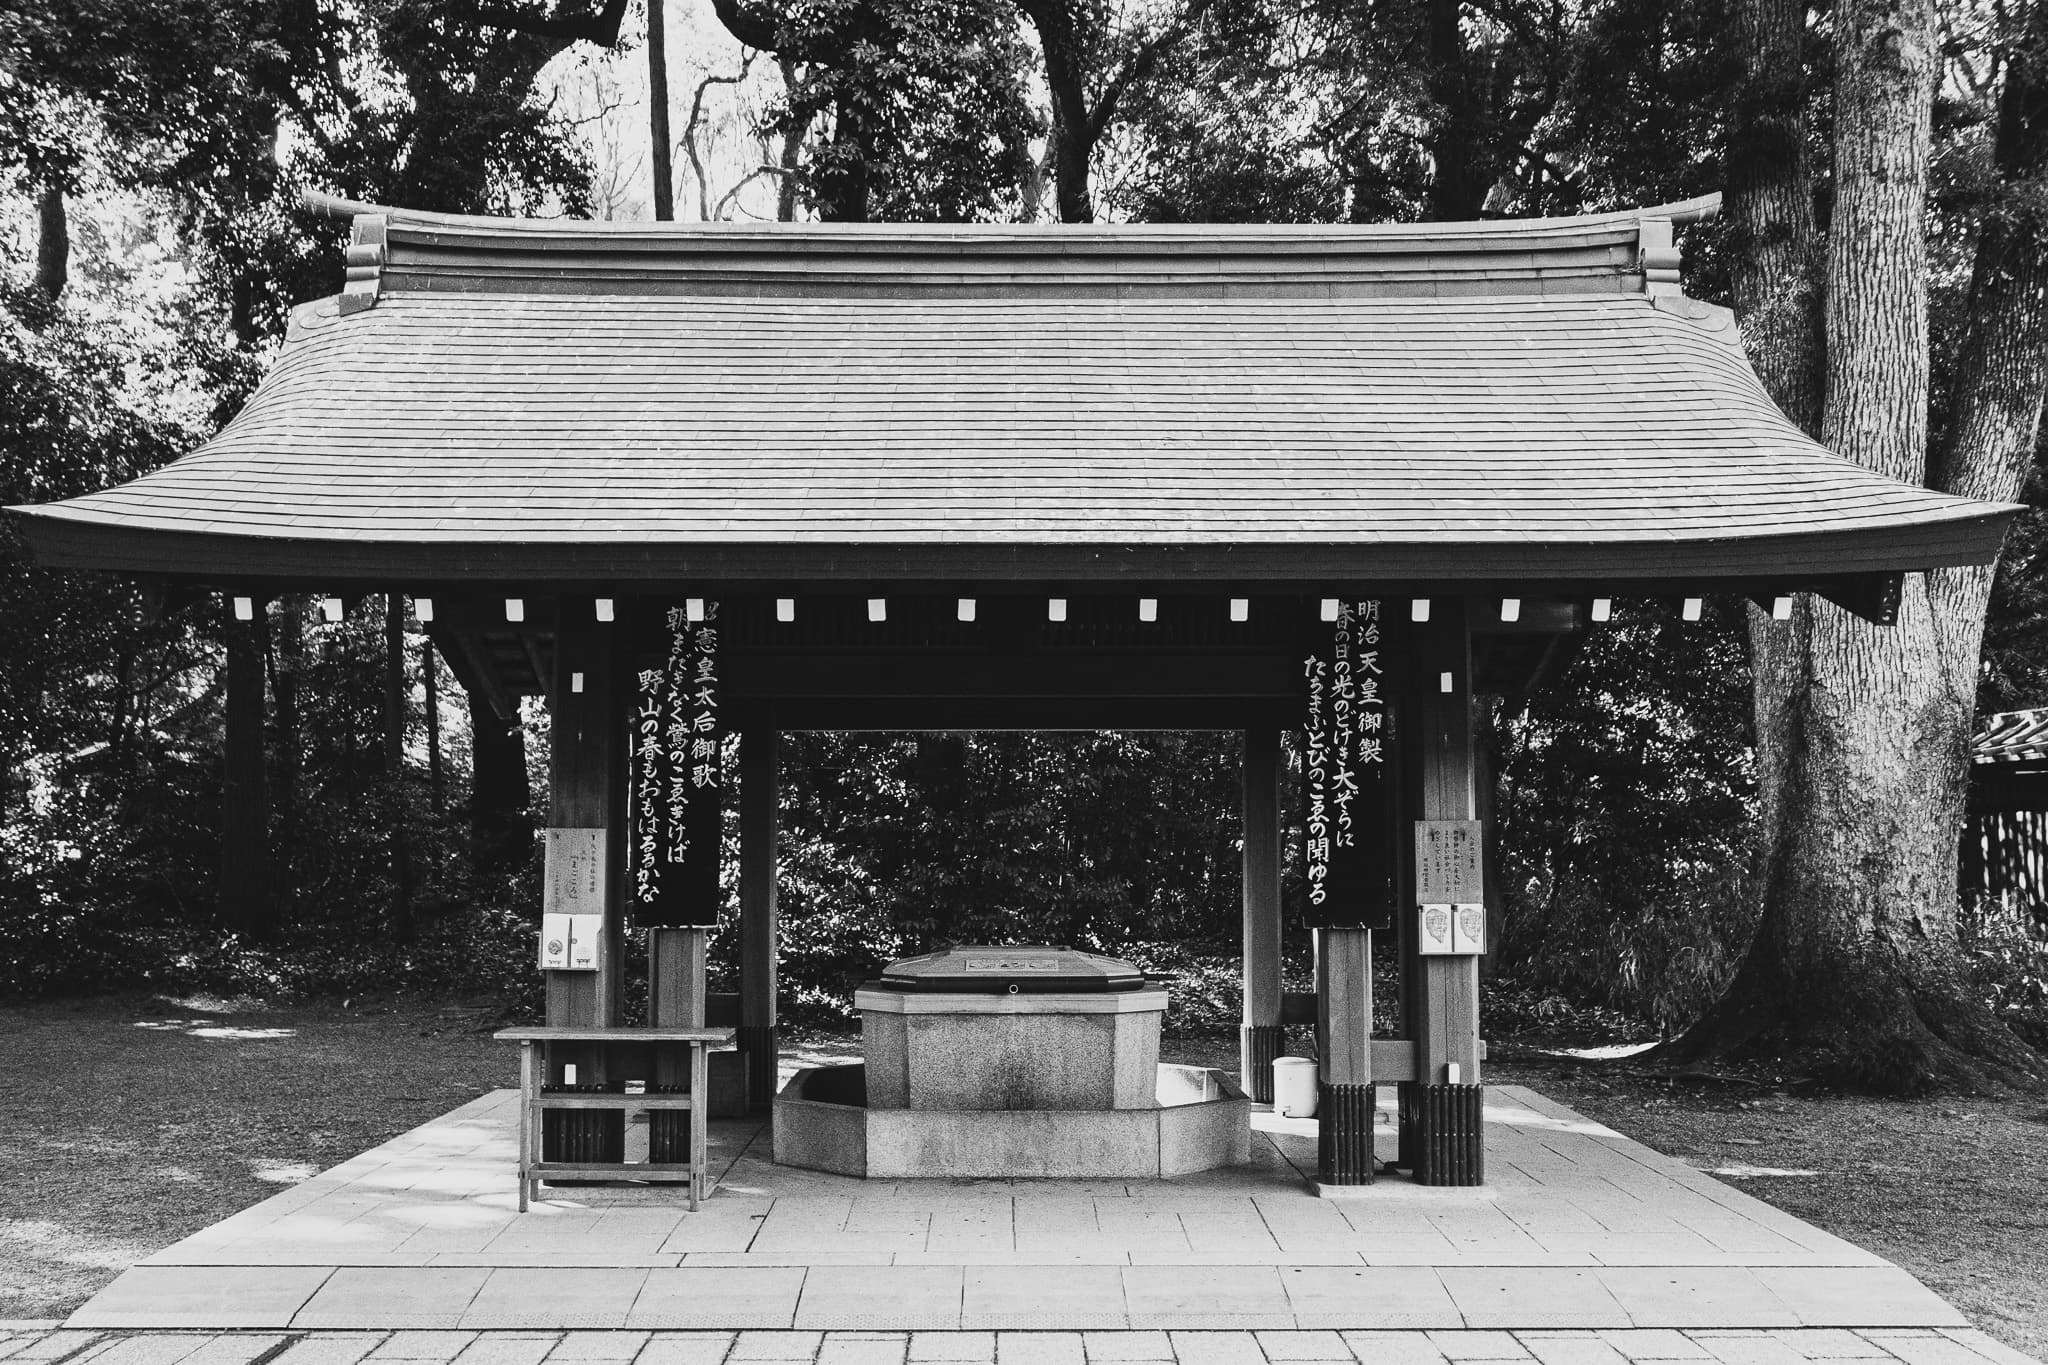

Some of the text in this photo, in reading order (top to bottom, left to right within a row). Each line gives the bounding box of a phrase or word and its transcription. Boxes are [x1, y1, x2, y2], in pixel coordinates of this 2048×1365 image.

[1357, 599, 1384, 764] 明治天皇御製
